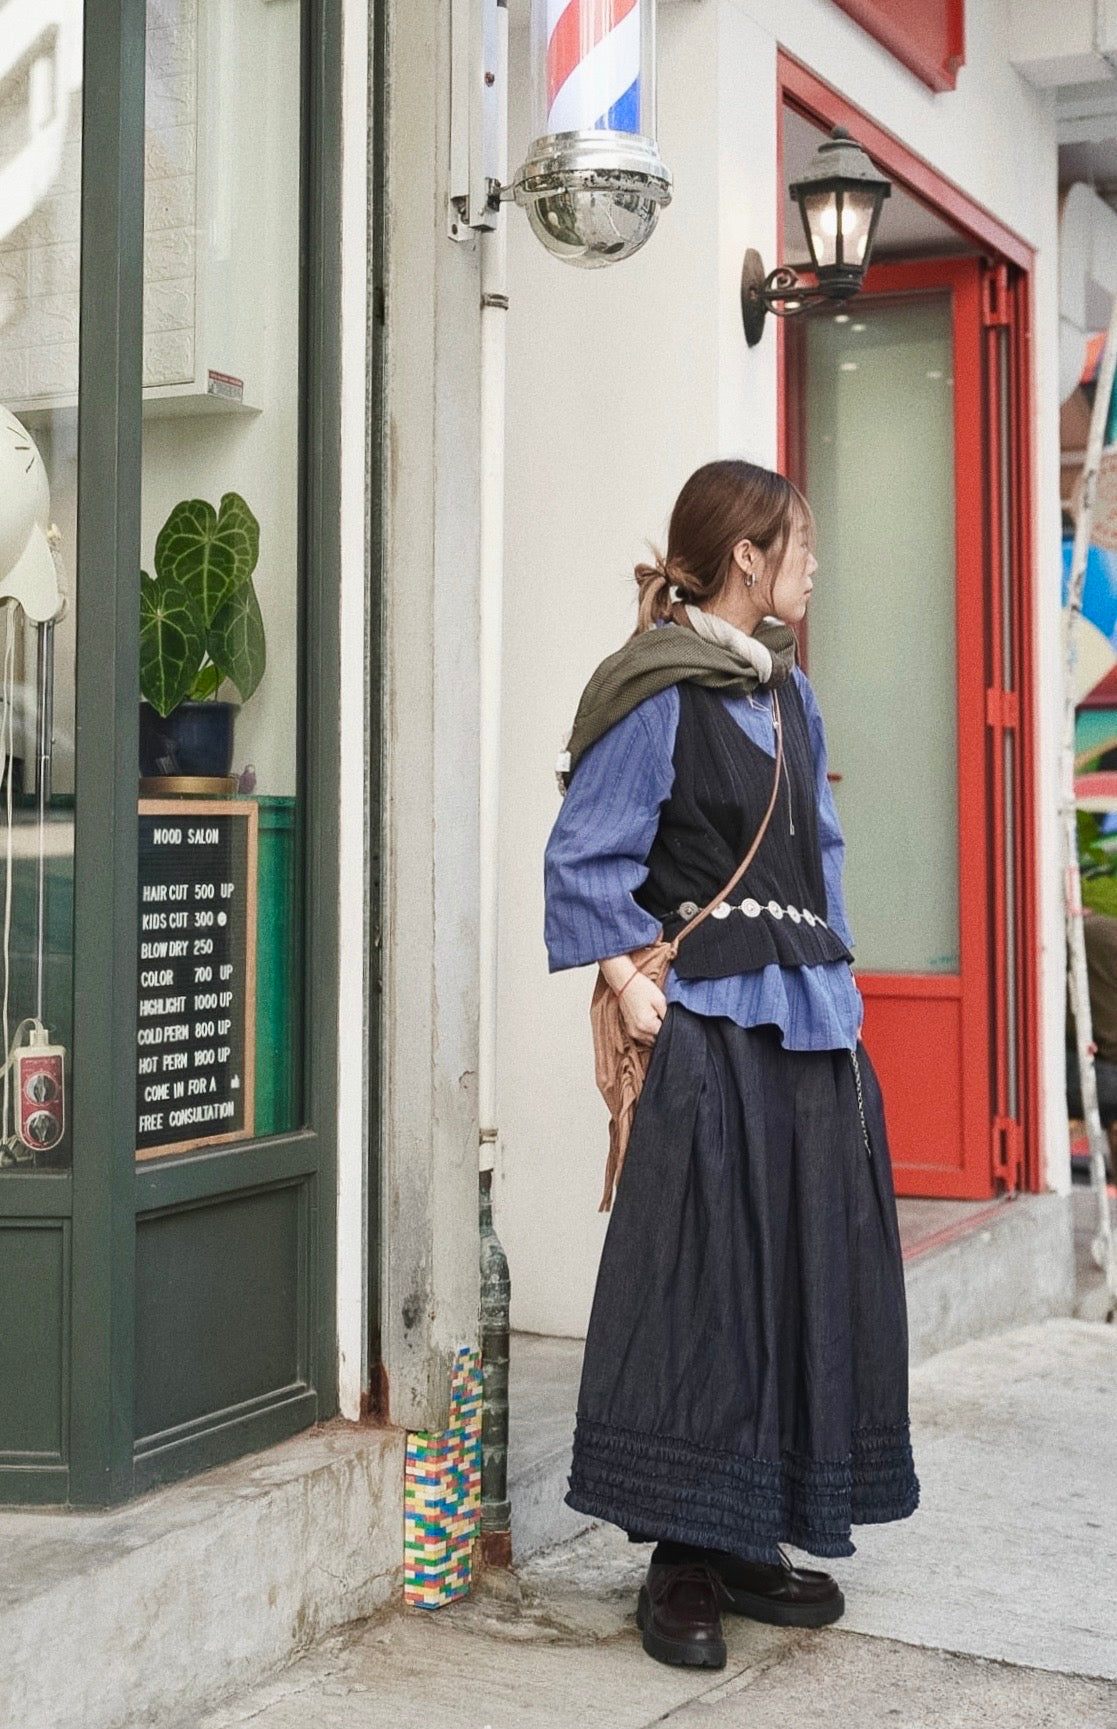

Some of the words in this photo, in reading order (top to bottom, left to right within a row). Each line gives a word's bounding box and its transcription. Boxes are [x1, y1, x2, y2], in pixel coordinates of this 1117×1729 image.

[187, 828, 219, 845] SALON
[194, 883, 215, 900] 500
[220, 883, 235, 898] UP
[194, 911, 214, 927] 300
[193, 939, 213, 955] 250
[141, 970, 174, 988] COLOR
[194, 966, 213, 983] 700
[219, 964, 233, 980] UP
[139, 996, 187, 1017] HIGHLIGHT
[194, 993, 218, 1011] 1000
[219, 991, 233, 1008] UP
[194, 1021, 215, 1038] 800
[217, 1019, 232, 1035] UP
[138, 1056, 158, 1075] HOT
[217, 1047, 231, 1062] UP
[144, 1083, 171, 1102] COME
[173, 1081, 184, 1099] IN
[187, 1077, 207, 1096] FOR
[209, 1076, 217, 1092] A
[138, 1113, 164, 1133] FREE
[168, 1101, 235, 1127] CONSULTATION
